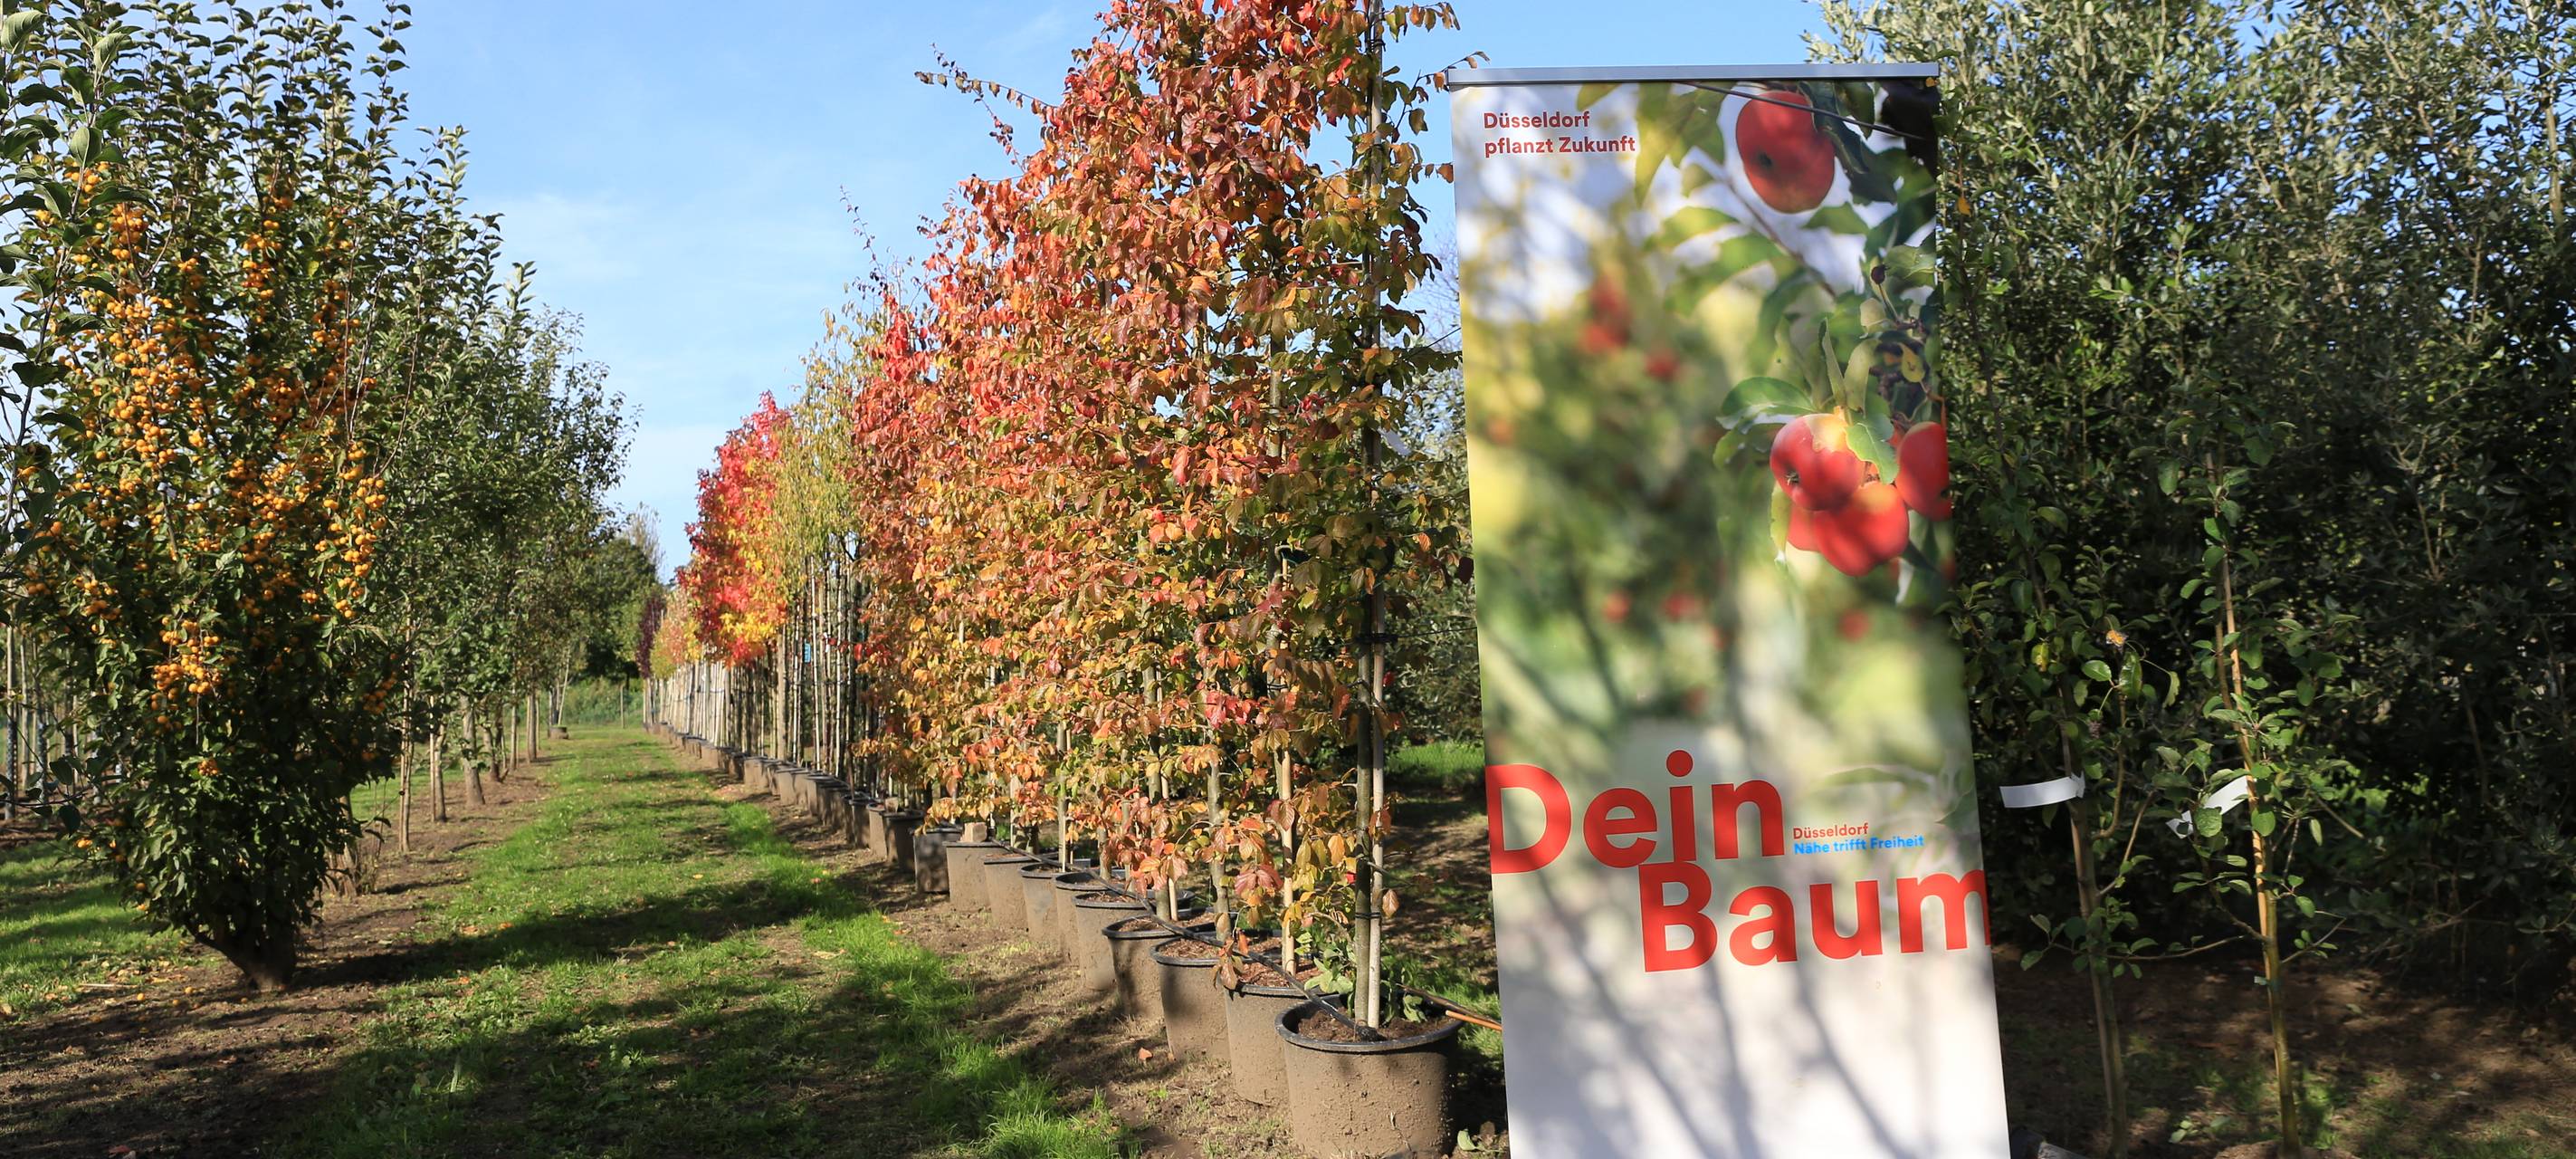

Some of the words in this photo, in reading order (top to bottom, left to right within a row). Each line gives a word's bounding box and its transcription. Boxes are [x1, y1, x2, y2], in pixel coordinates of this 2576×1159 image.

[1484, 110, 1590, 129] Düsseldorf
[1484, 138, 1554, 158] pflanzt
[1559, 136, 1636, 153] Zukunft
[1484, 750, 1785, 875] Dein
[1793, 822, 1869, 839] Düsseldorf
[1793, 840, 1830, 855] Nähe
[1833, 838, 1867, 852] trifft
[1870, 835, 1925, 849] Freiheit
[1638, 861, 1991, 972] Baum
